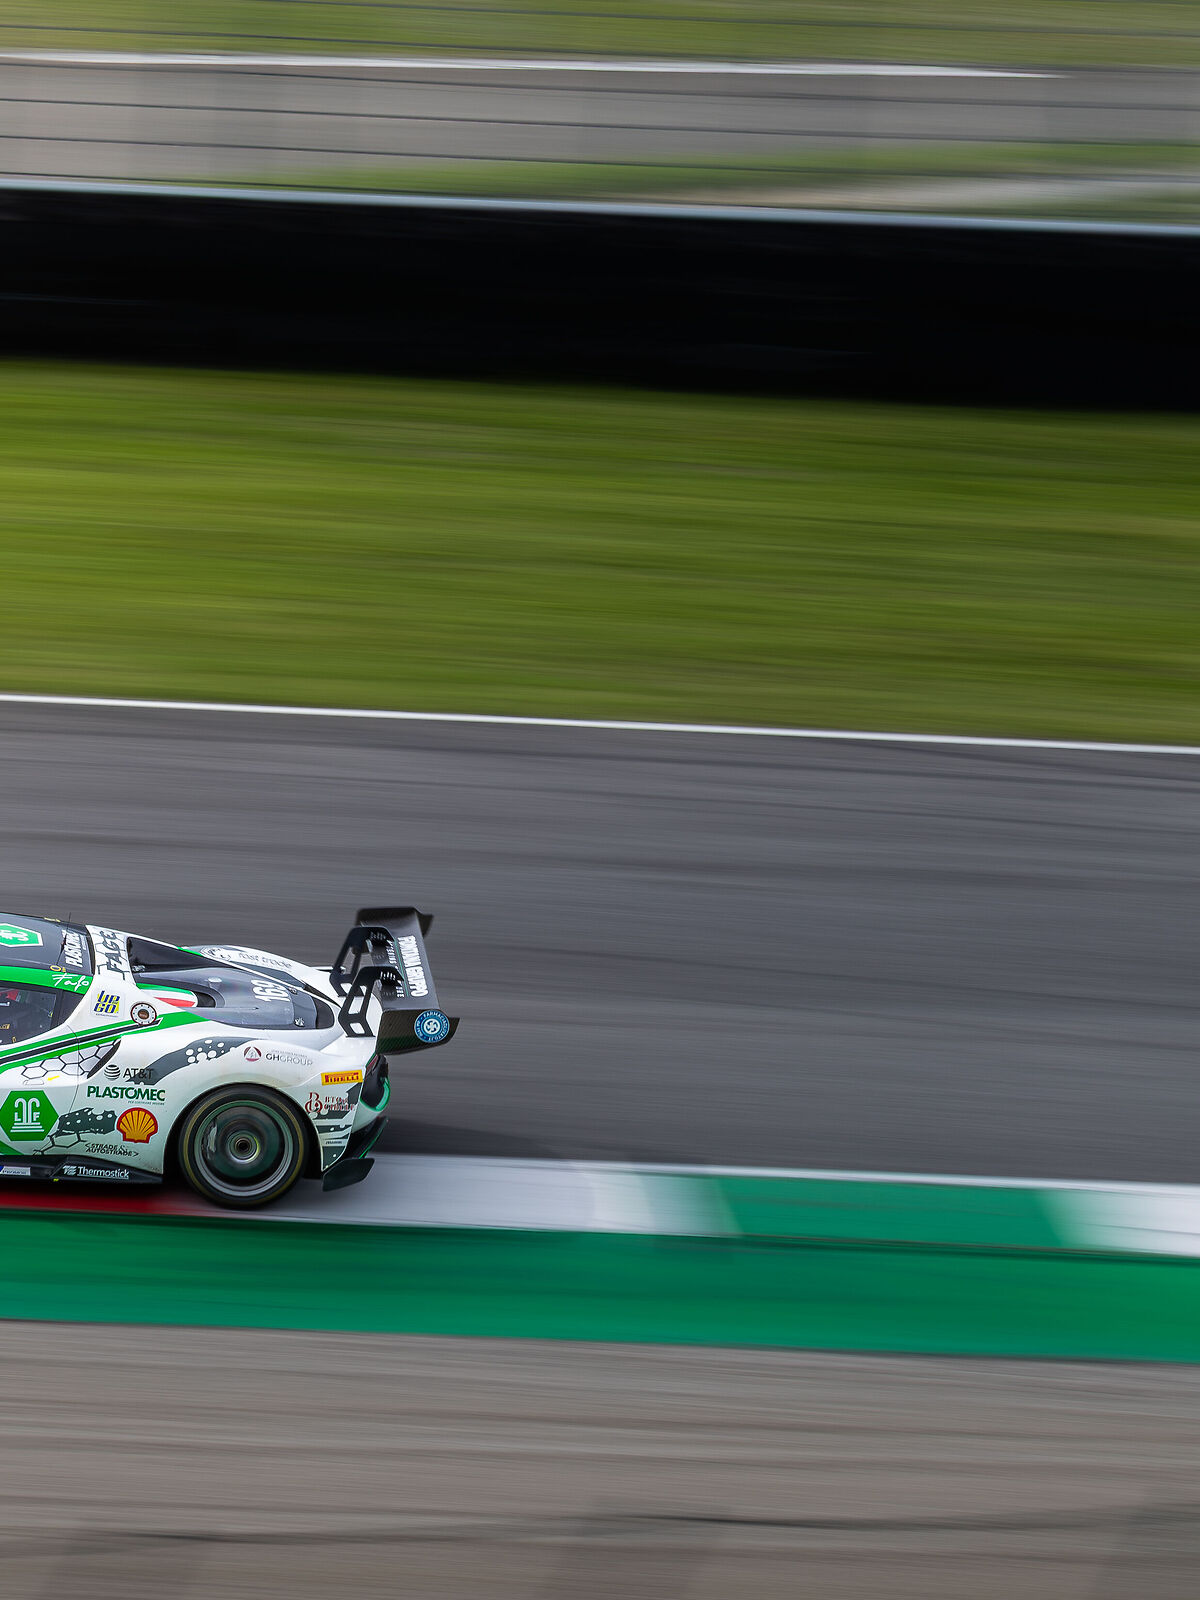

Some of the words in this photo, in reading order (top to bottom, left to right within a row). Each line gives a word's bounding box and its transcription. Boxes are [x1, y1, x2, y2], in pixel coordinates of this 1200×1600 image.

[405, 966, 429, 997] GRUPPO
[123, 1067, 155, 1079] AT&T
[87, 1085, 166, 1102] PLASTOMEC
[77, 1166, 130, 1179] Thermostick
